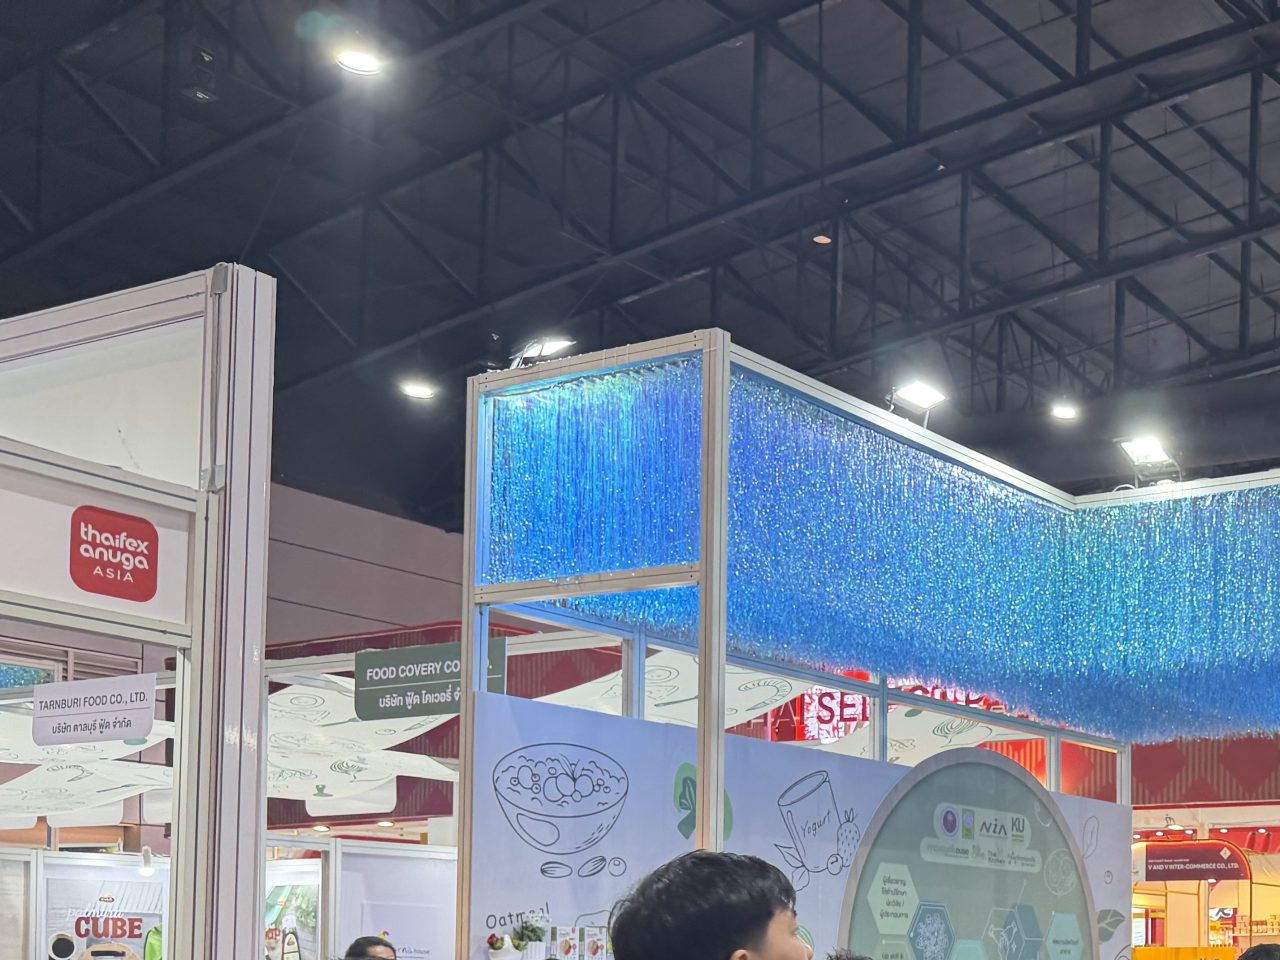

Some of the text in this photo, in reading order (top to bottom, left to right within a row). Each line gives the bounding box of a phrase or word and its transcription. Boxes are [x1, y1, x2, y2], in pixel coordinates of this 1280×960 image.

[80, 521, 149, 555] thaifex
[80, 543, 149, 571] anuga
[93, 566, 134, 583] ASIA
[366, 667, 397, 681] FOOD
[398, 661, 442, 678] COVERY
[39, 691, 148, 711] TARNBURI FOOD CO., LTD.
[379, 693, 403, 708] บริษัท
[52, 722, 72, 735] บริษัท
[801, 809, 831, 838] Yogurt
[1011, 816, 1025, 833] KU
[74, 916, 143, 939] CUBE
